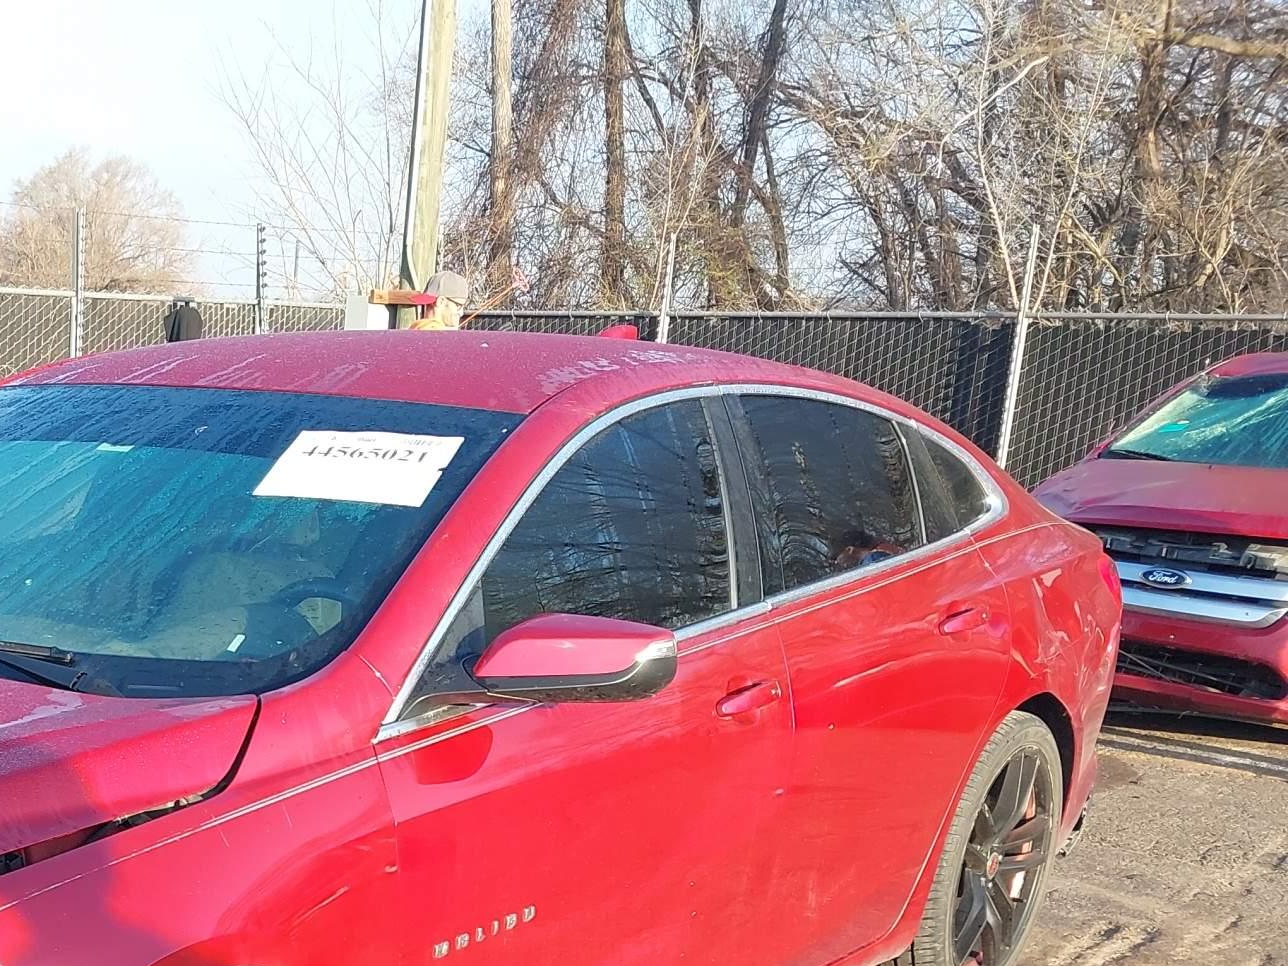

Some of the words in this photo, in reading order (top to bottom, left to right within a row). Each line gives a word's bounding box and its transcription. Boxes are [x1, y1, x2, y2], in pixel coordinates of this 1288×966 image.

[302, 444, 429, 464] 44565021
[1148, 570, 1178, 584] Ford
[432, 904, 537, 959] MALIBU
